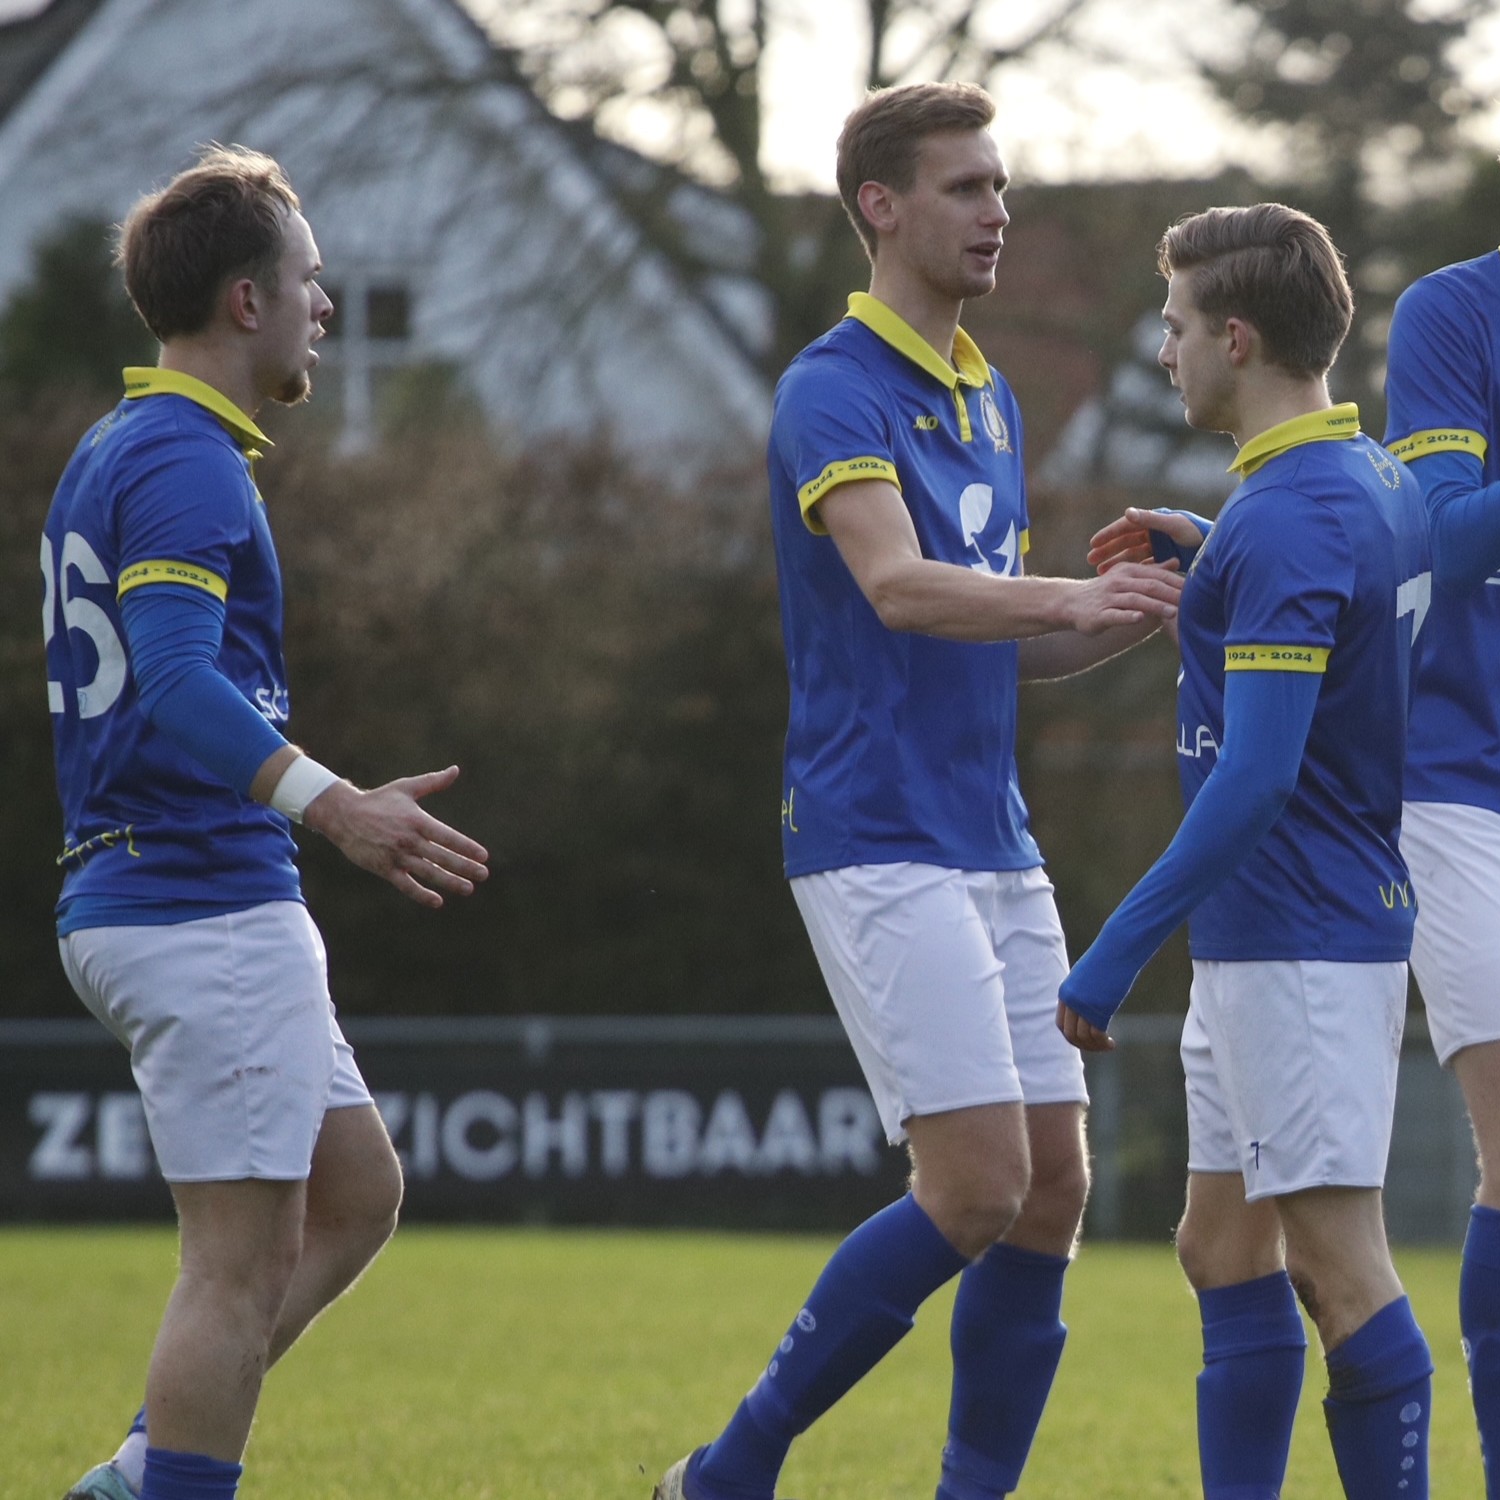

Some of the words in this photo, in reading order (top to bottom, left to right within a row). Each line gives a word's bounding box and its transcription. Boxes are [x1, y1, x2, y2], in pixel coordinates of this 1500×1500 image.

[1426, 434, 1470, 444] 2024
[806, 469, 834, 496] 1924
[848, 461, 888, 472] 2024
[166, 567, 209, 585] 2024
[1228, 651, 1256, 661] 1924
[1270, 651, 1313, 663] 2024
[28, 1091, 153, 1181] ZE
[1250, 1141, 1260, 1171] 7
